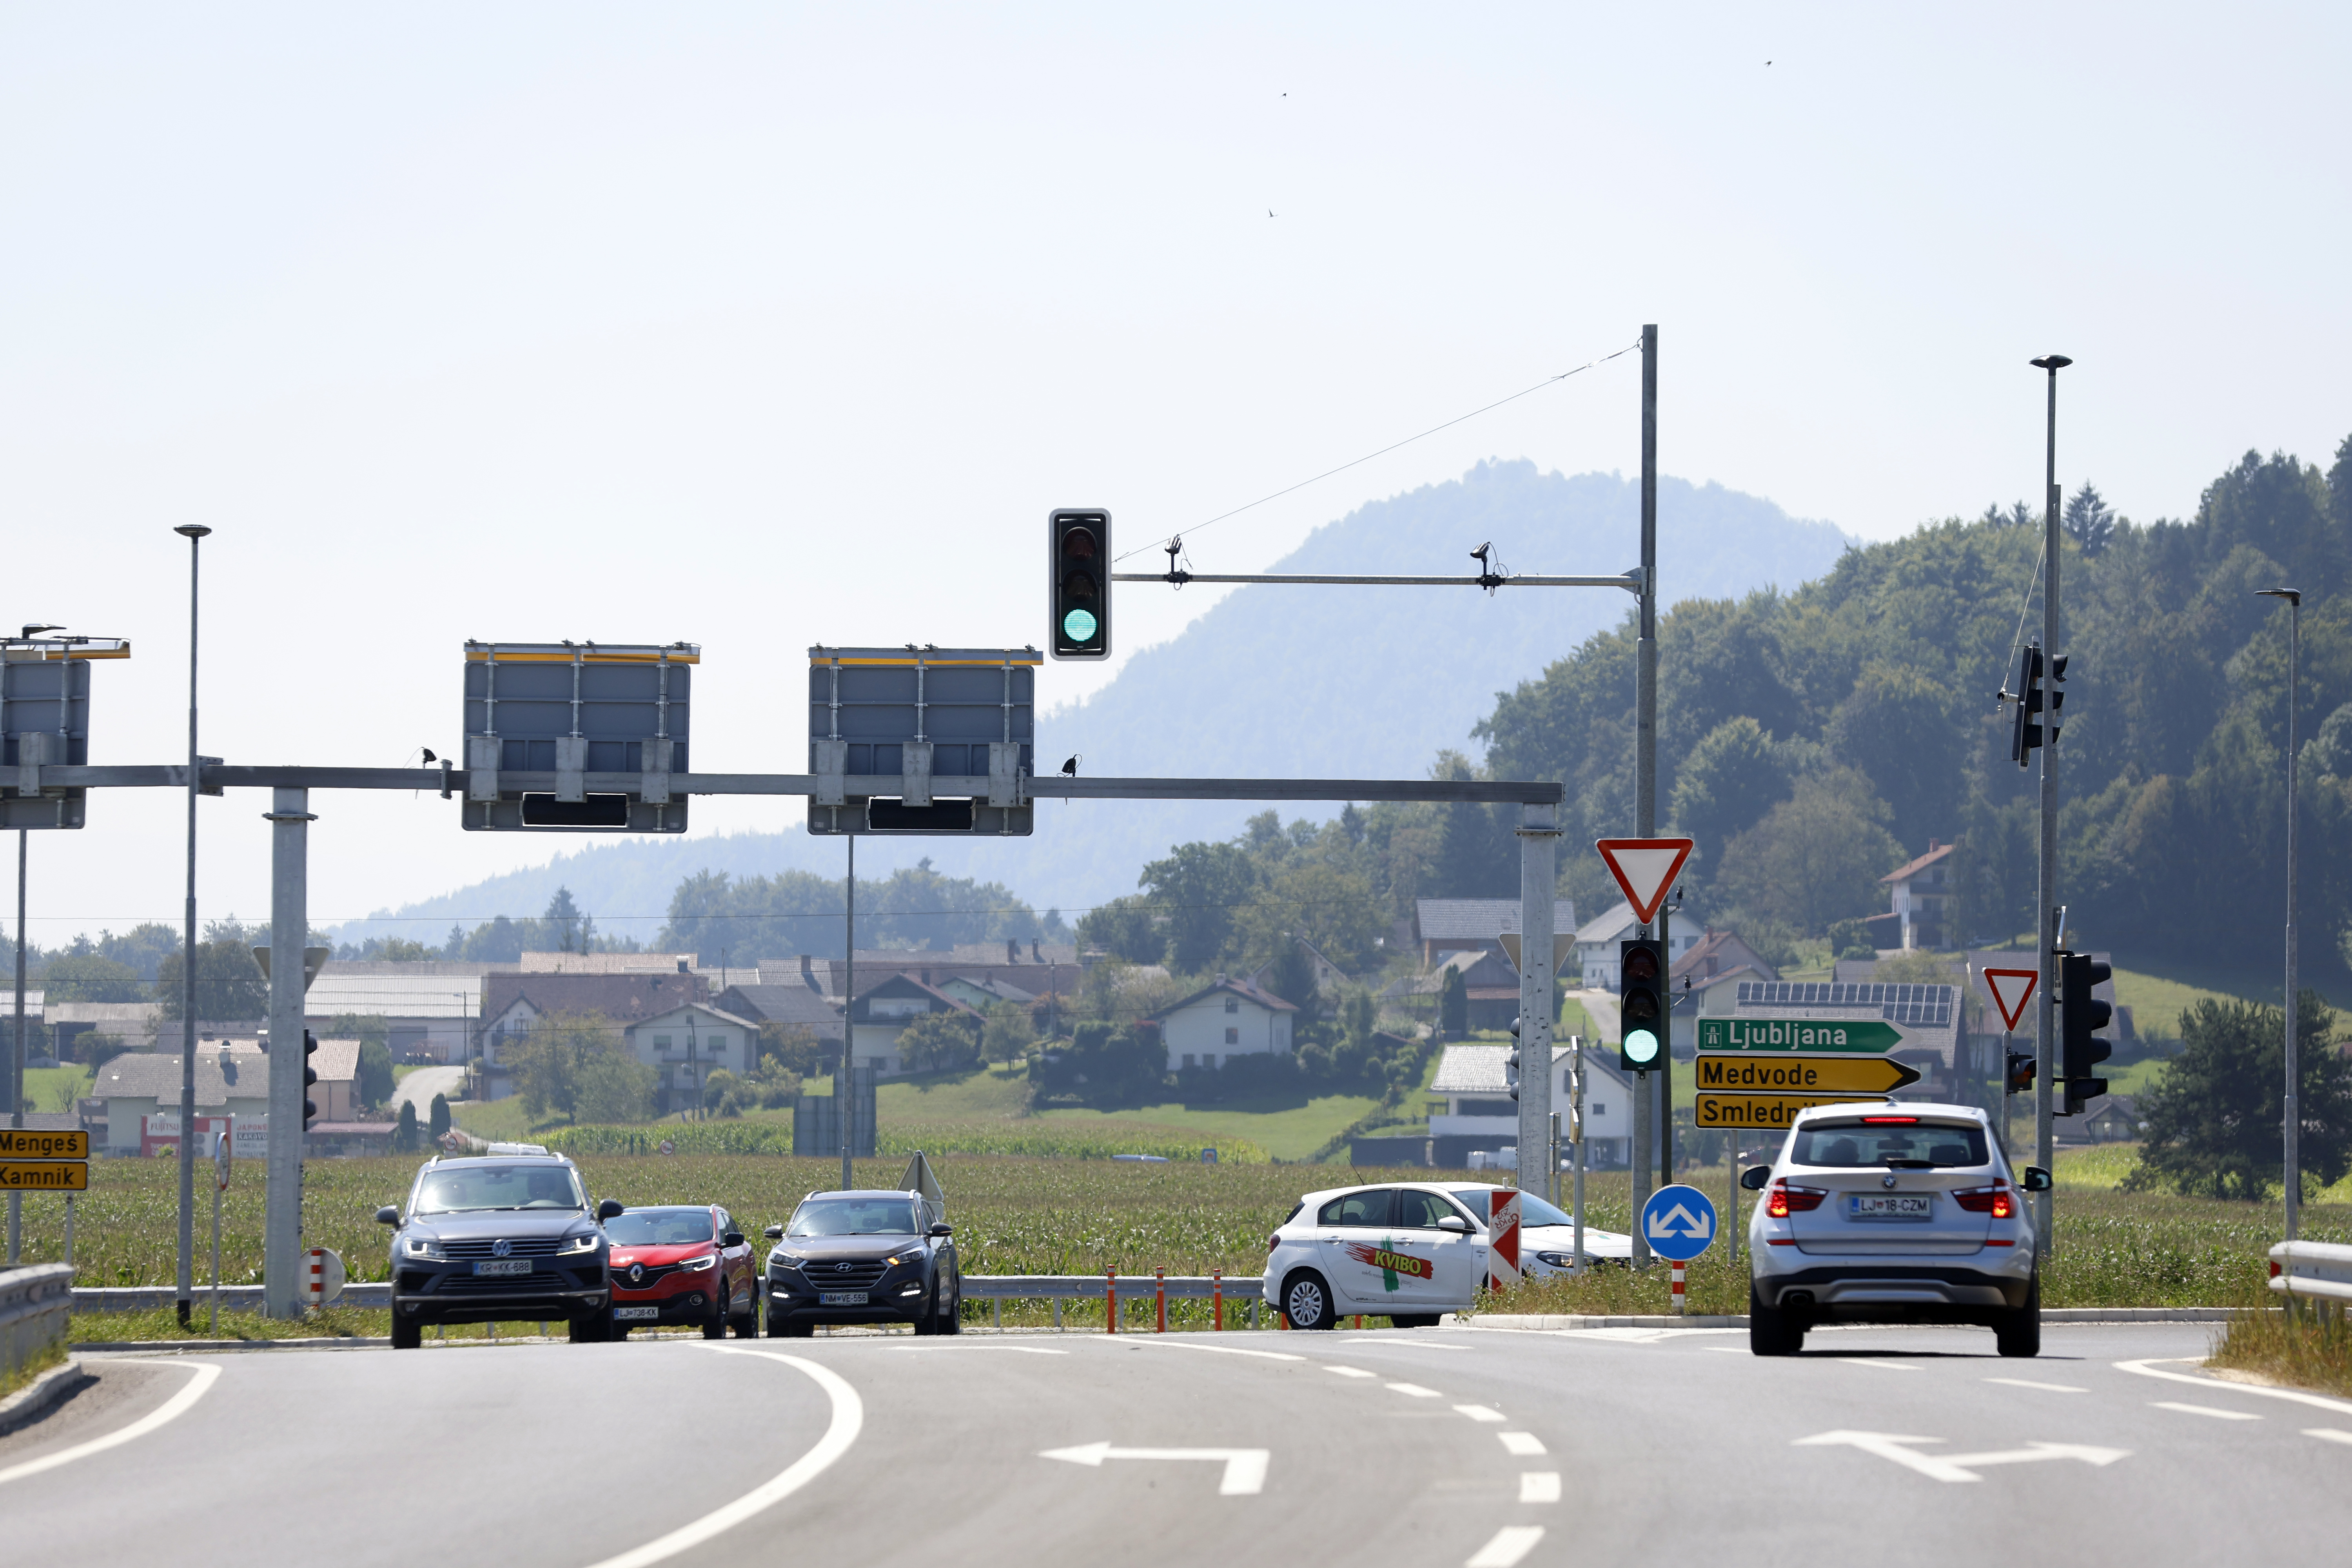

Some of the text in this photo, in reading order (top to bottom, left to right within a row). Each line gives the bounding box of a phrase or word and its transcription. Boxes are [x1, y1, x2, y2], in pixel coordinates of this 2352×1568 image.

[1729, 1022, 1847, 1050] Ljubljana
[1704, 1062, 1818, 1085] Medvode
[1703, 1099, 1816, 1123] Smledn
[151, 1123, 179, 1132] FUJITSU
[237, 1123, 267, 1131] JAPONS
[0, 1133, 78, 1156] Mengeš
[0, 1167, 74, 1185] Kamnik
[1861, 1199, 1927, 1211] LJ 18-CZM
[480, 1263, 491, 1273] KR
[1374, 1250, 1421, 1274] KVIBO
[825, 1294, 867, 1303] NM VE-556
